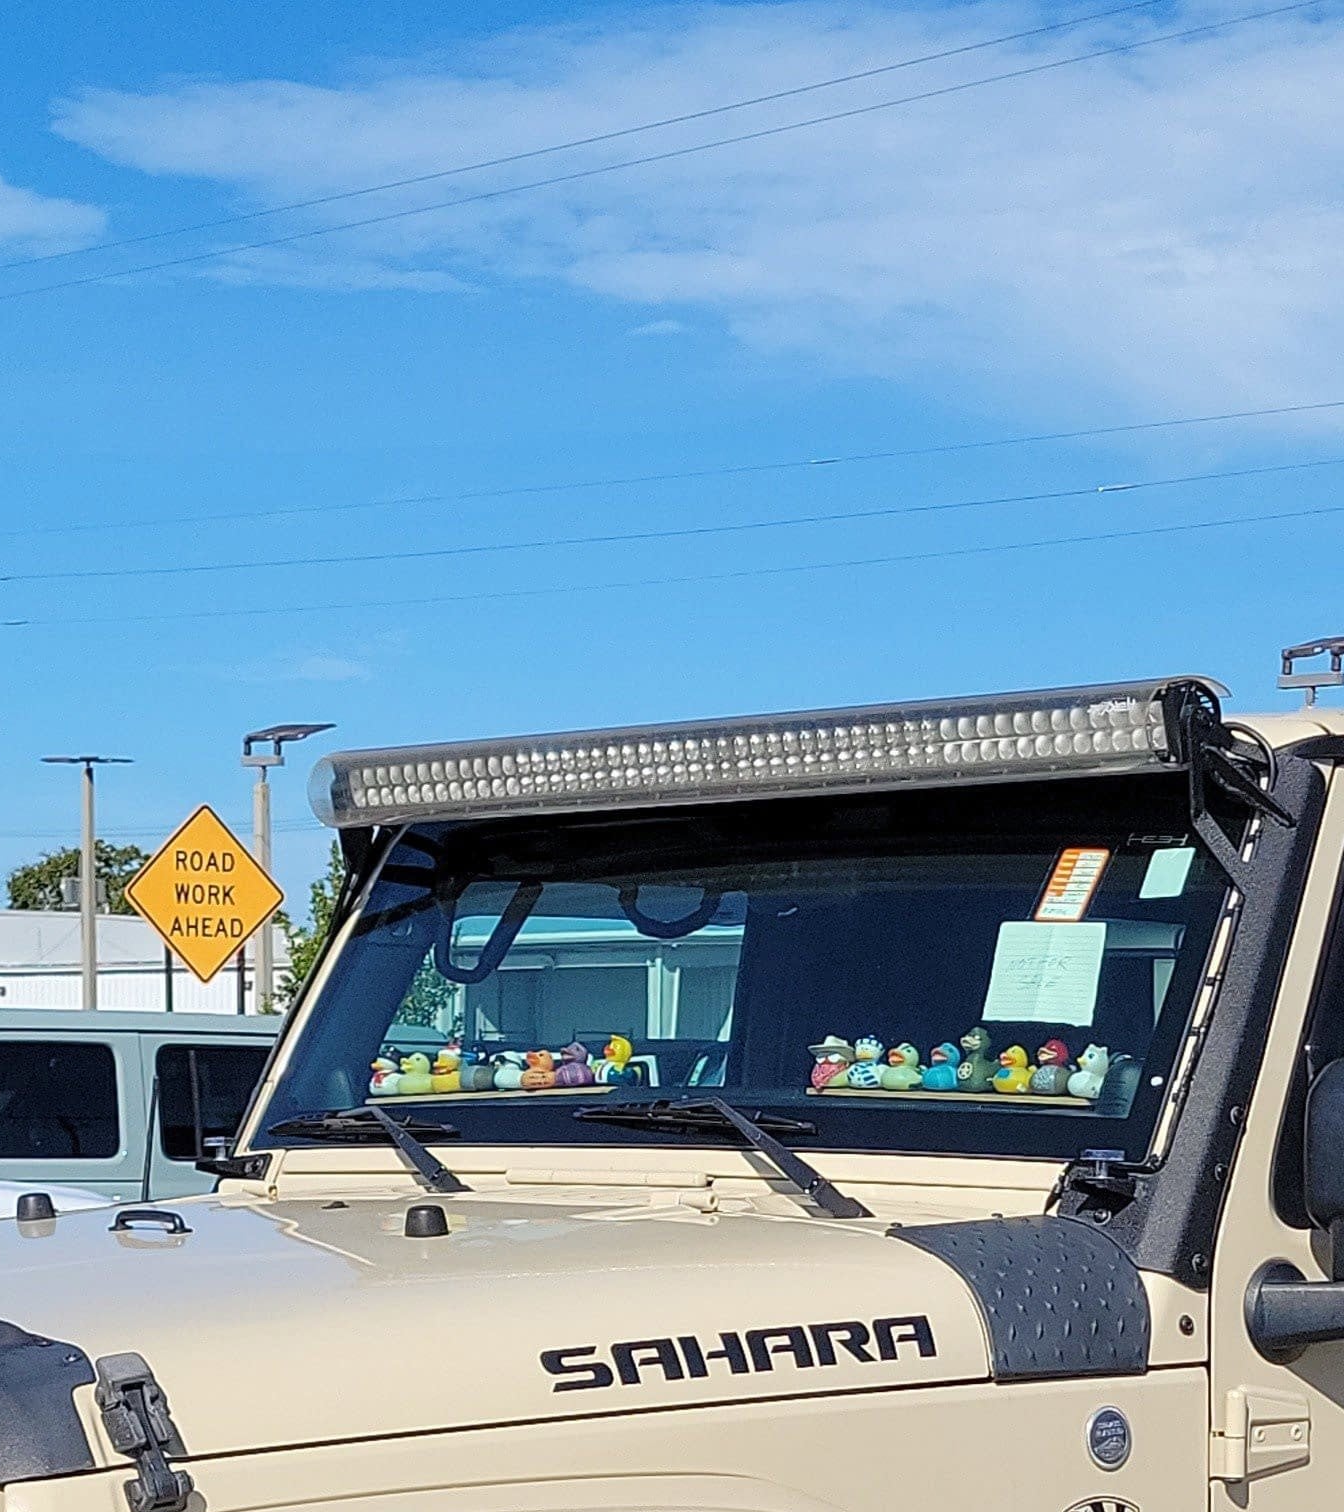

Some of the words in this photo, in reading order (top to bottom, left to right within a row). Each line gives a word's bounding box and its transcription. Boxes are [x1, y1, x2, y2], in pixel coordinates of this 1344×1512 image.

[175, 850, 235, 872] ROAD
[174, 883, 235, 905] WORK
[169, 916, 244, 938] AHEAD
[539, 1315, 938, 1393] SAHARA
